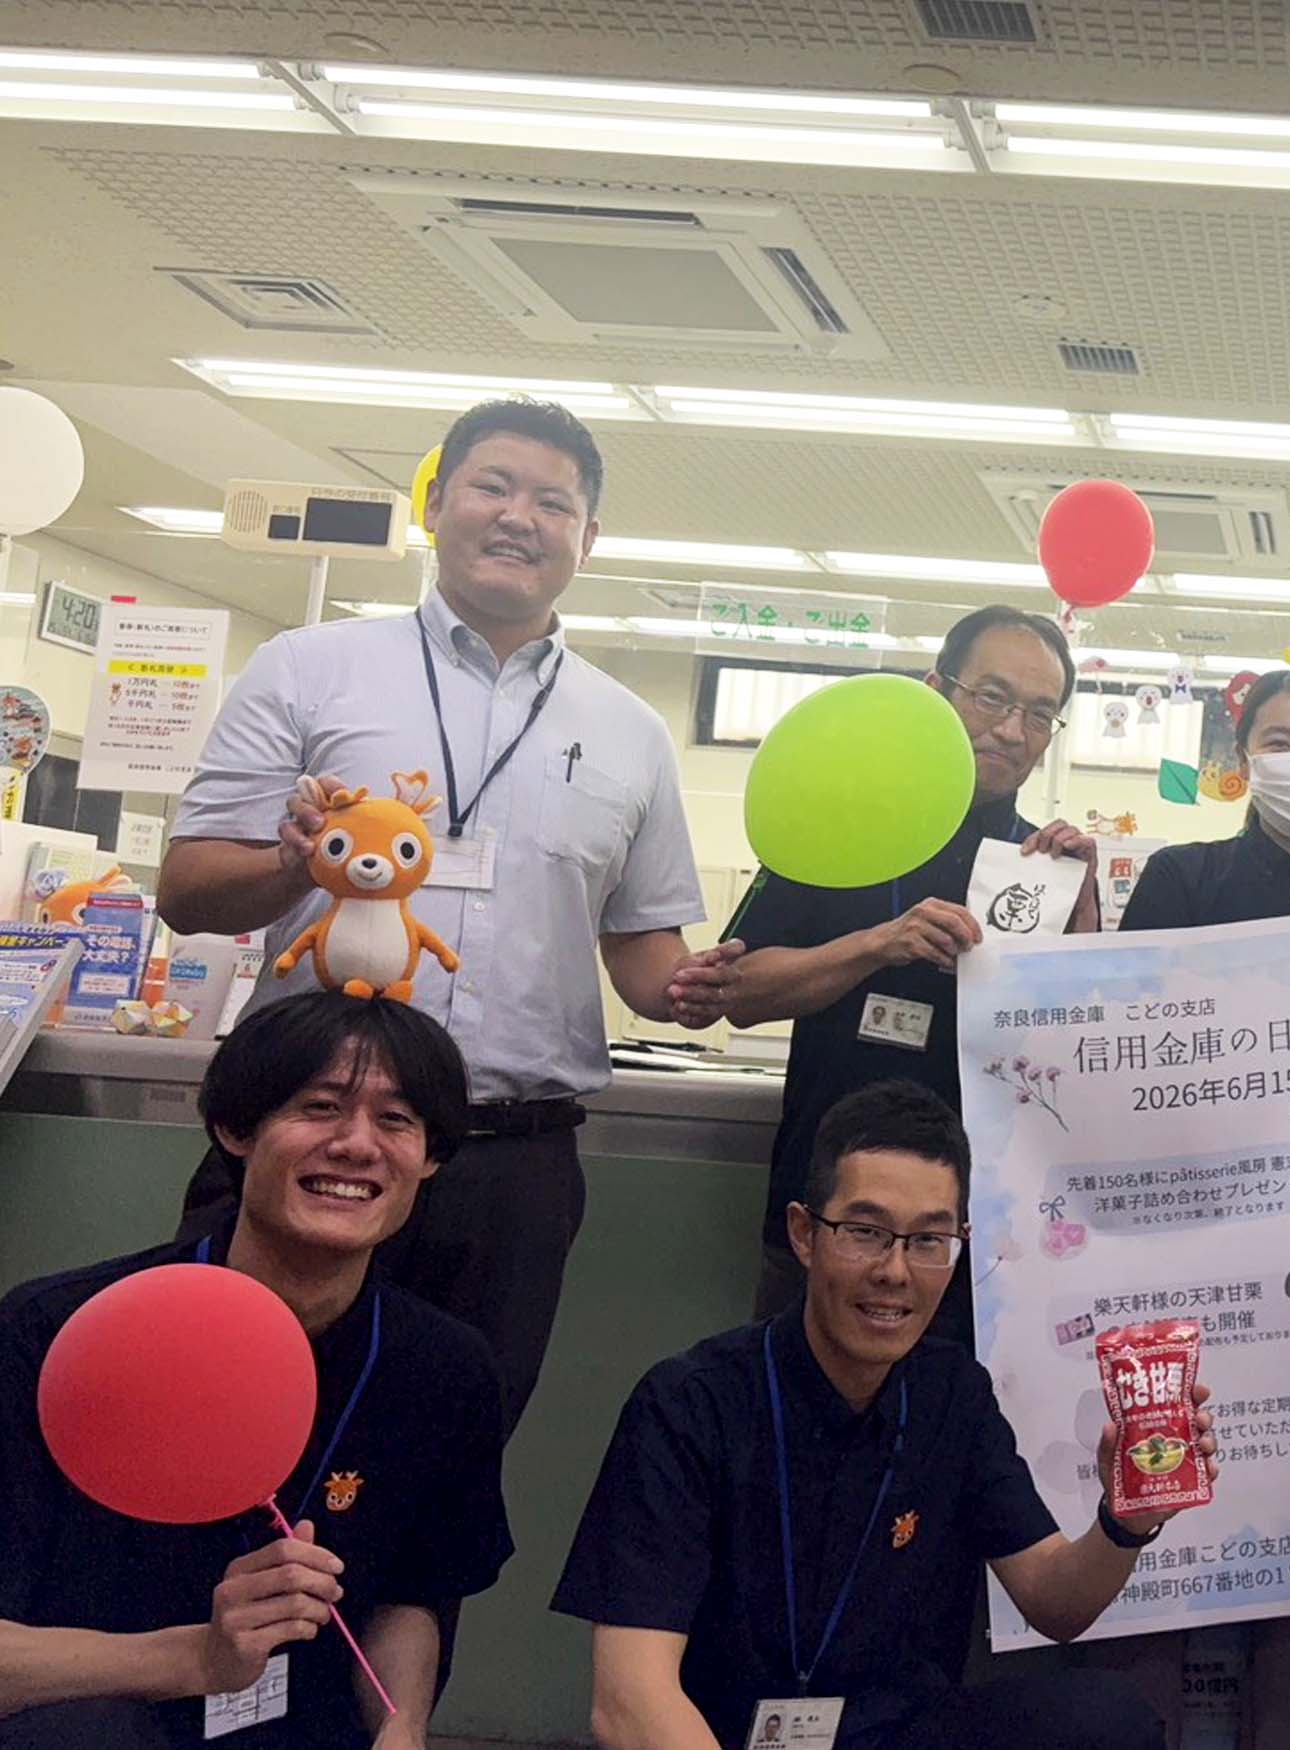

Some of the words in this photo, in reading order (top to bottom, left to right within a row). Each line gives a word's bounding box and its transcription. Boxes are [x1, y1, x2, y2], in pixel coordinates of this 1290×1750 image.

[994, 1006, 1105, 1029] 奈良信用金庫
[1125, 998, 1216, 1021] こどの支店
[1094, 1281, 1264, 1317] 樂天軒様の天津甘栗
